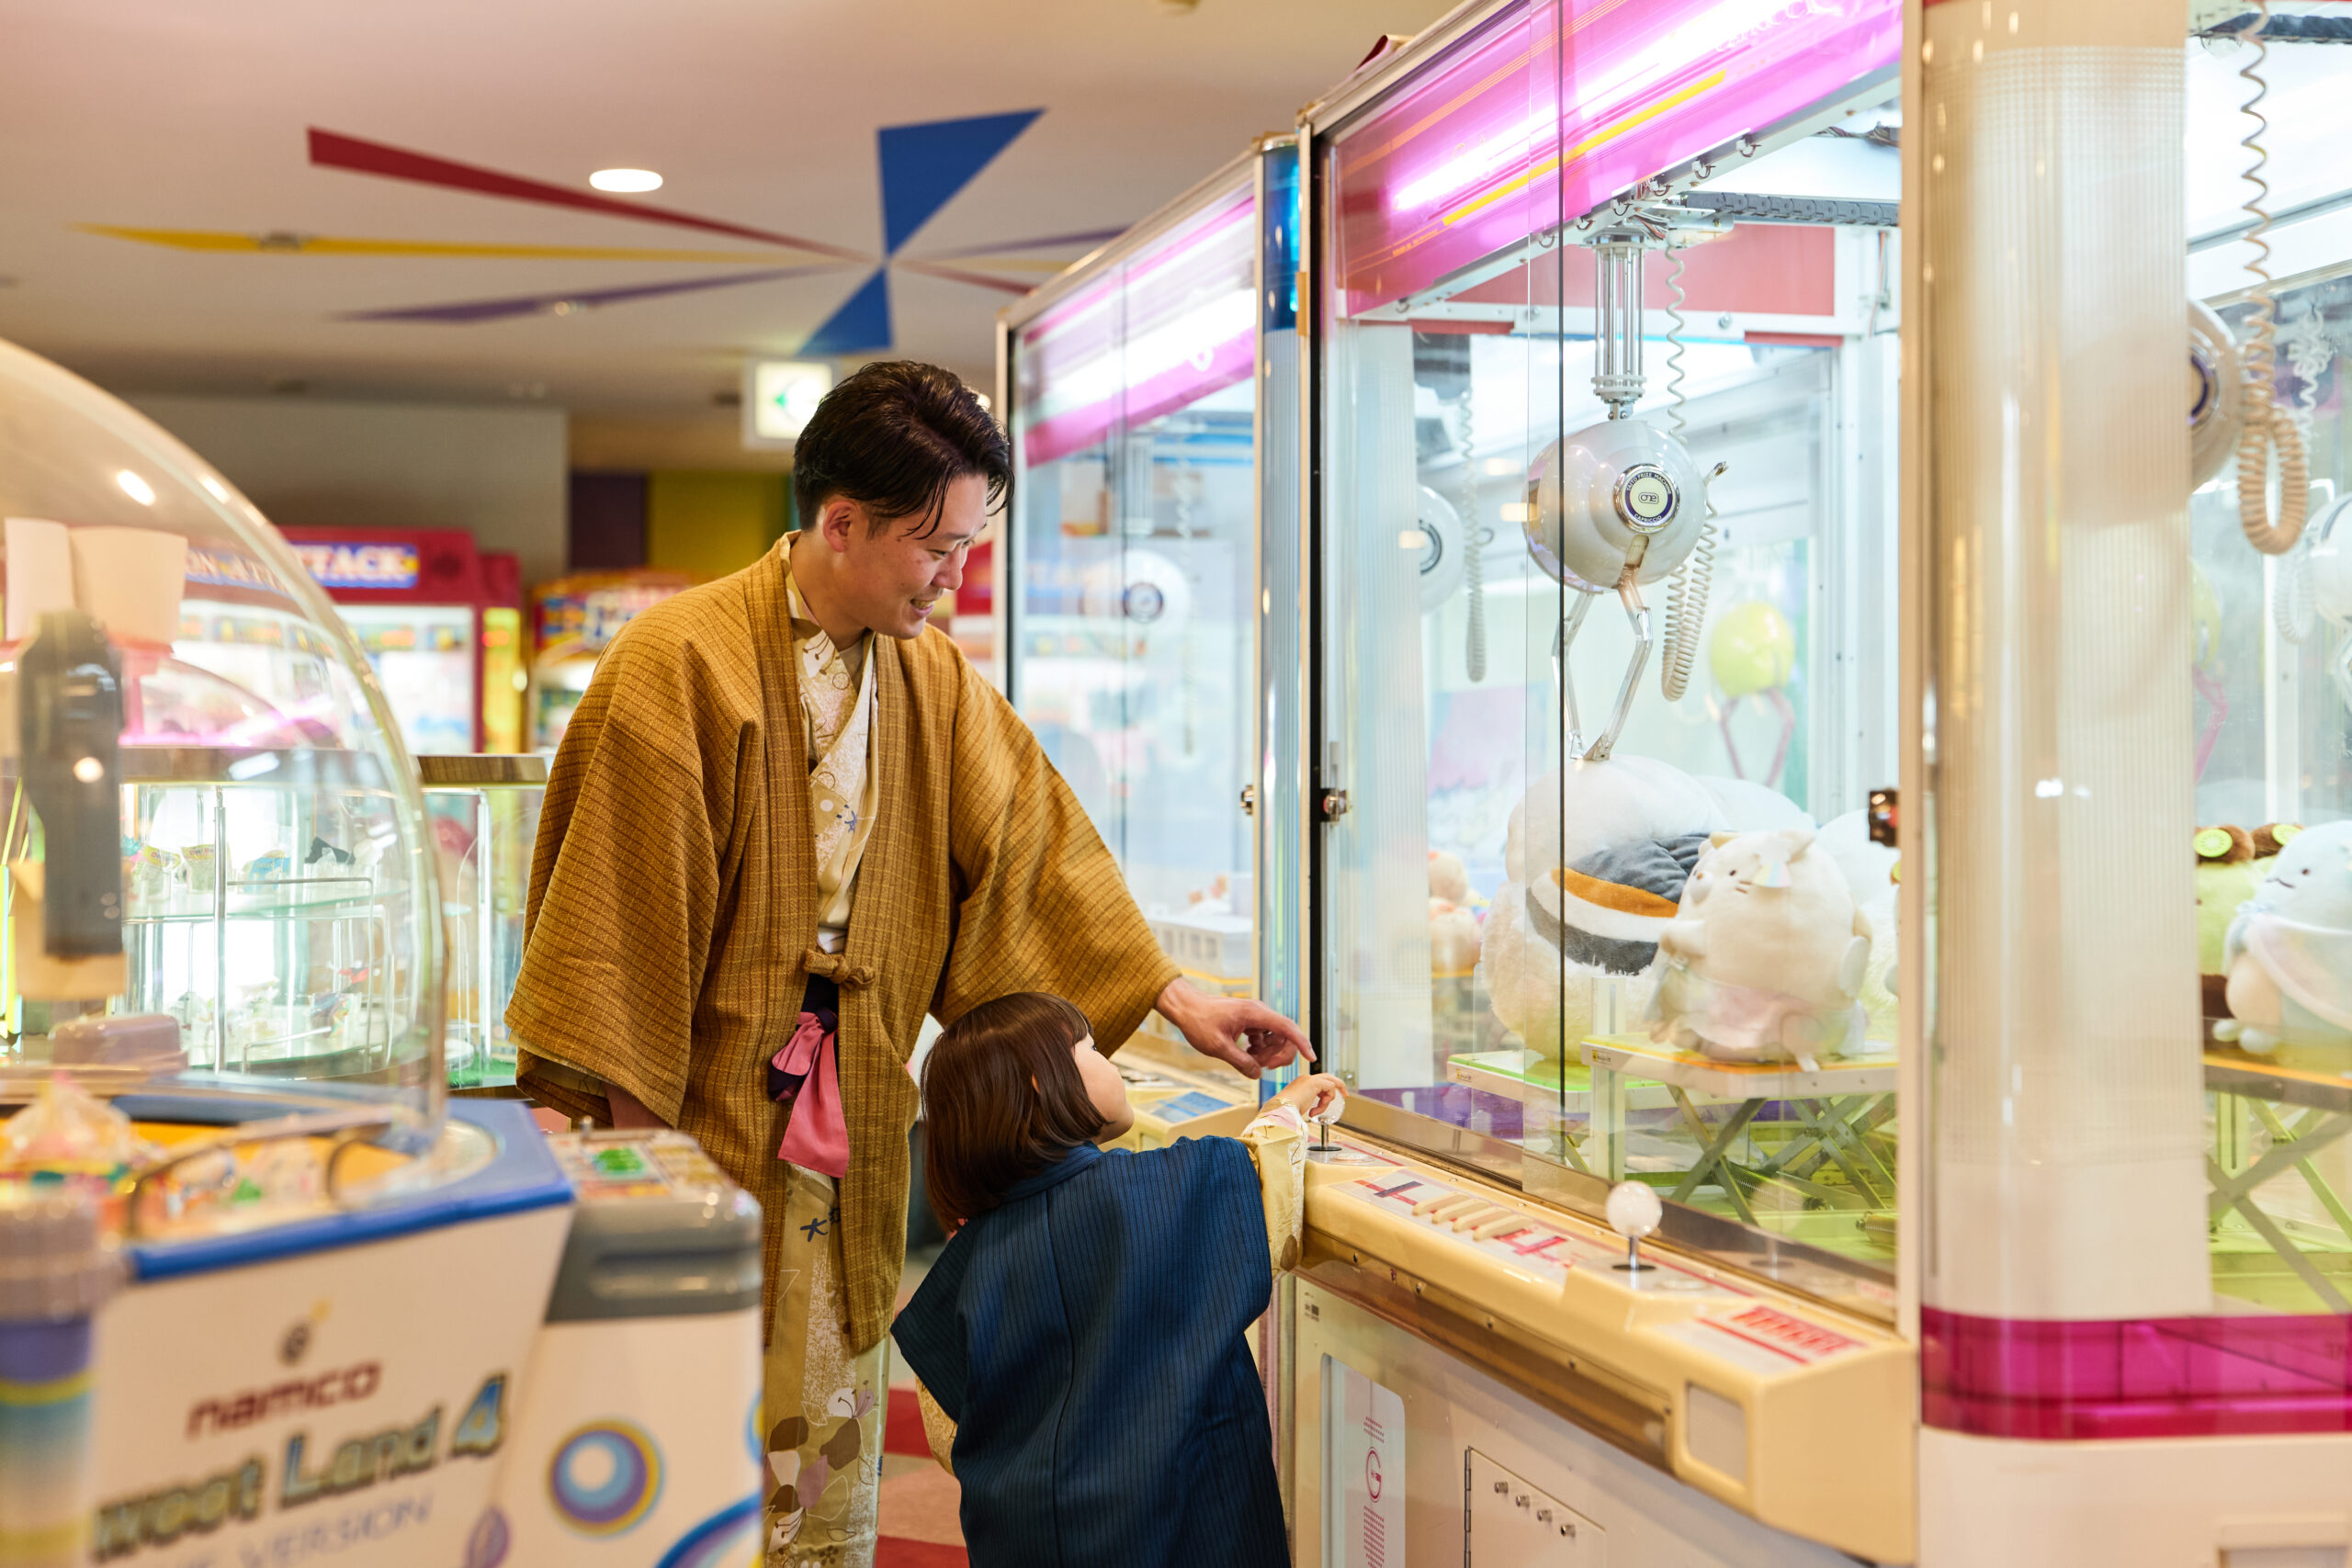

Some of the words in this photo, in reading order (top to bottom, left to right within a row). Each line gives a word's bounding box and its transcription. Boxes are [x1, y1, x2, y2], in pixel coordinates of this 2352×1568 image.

[1655, 473, 1672, 494] MACHINE
[1634, 513, 1662, 523] CAPRICCIO
[187, 1360, 381, 1440] namco
[90, 1455, 265, 1564] weet
[279, 1402, 440, 1509] Land
[453, 1372, 508, 1458] 4
